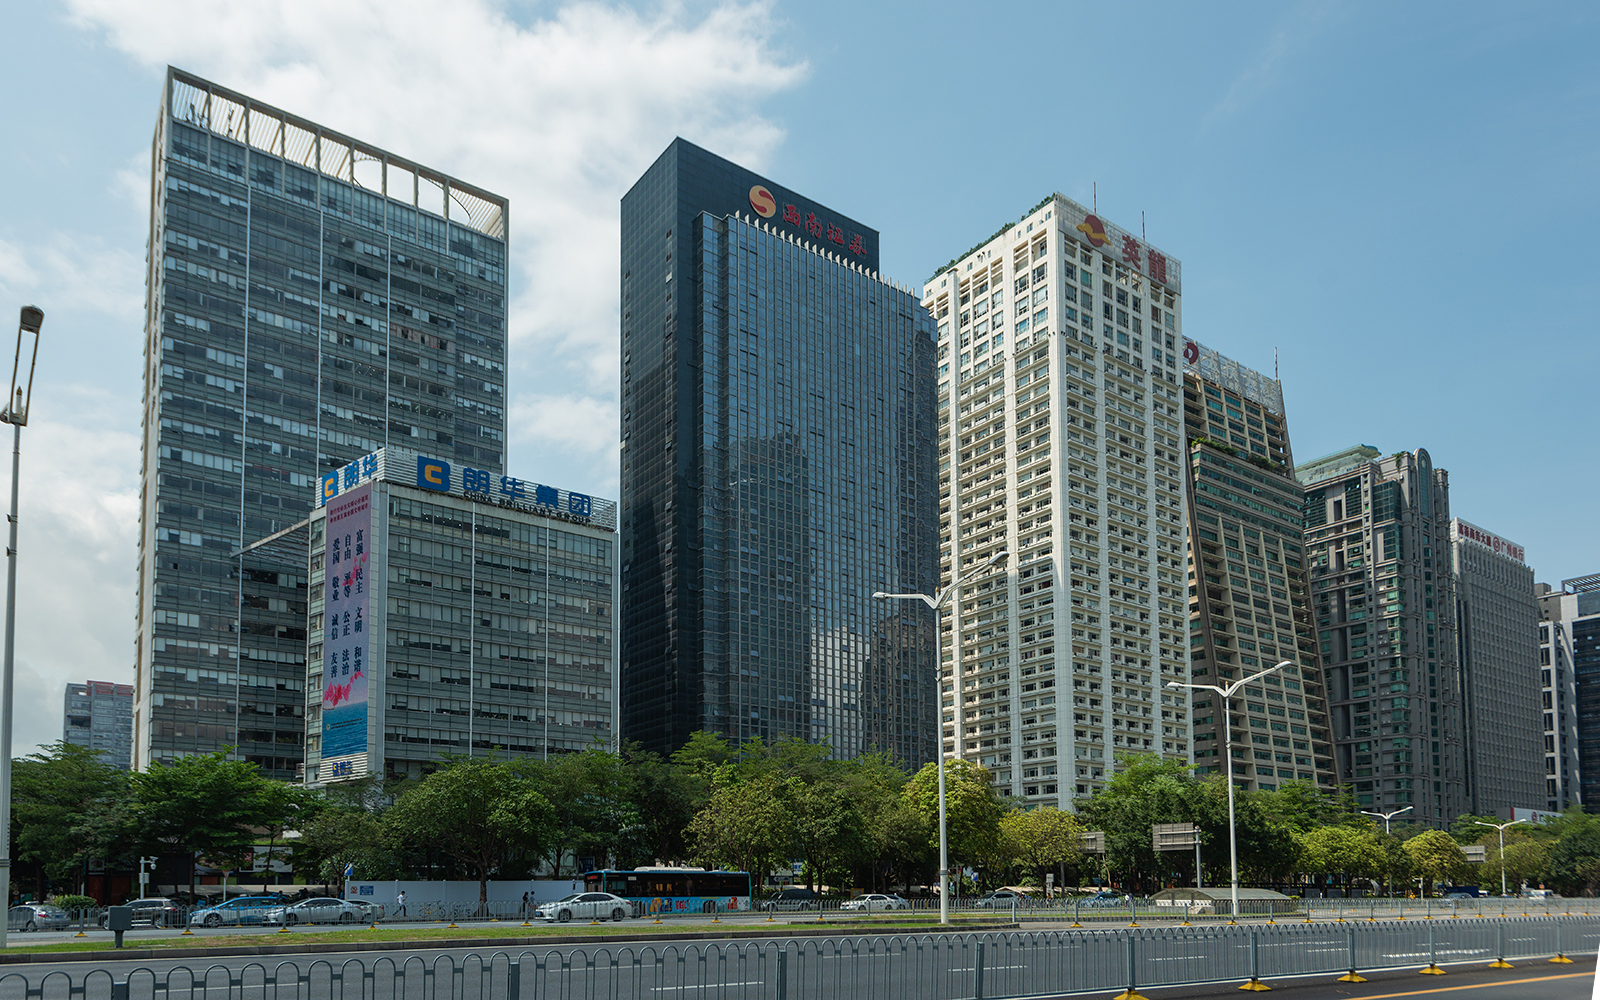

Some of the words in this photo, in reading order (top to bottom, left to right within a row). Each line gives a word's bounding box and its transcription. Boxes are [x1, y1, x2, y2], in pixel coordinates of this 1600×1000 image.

[783, 204, 867, 255] 西南证券
[1122, 234, 1167, 284] 英龍
[344, 453, 378, 489] 朗华
[462, 467, 592, 517] 朗华集团
[463, 490, 493, 503] CHINA
[500, 499, 552, 517] BRILLIANT
[556, 512, 591, 524] GROUP
[332, 538, 340, 565] 爱国
[344, 534, 351, 561] 自由
[356, 529, 364, 556] 富强
[332, 576, 339, 602] 敬业
[343, 571, 351, 598] 平等
[355, 568, 363, 595] 民主
[331, 613, 339, 640] 诚信
[343, 610, 350, 637] 公正
[355, 607, 362, 634] 文明
[330, 652, 338, 678] 友善
[342, 649, 349, 676] 法治
[354, 646, 361, 672] 和谐
